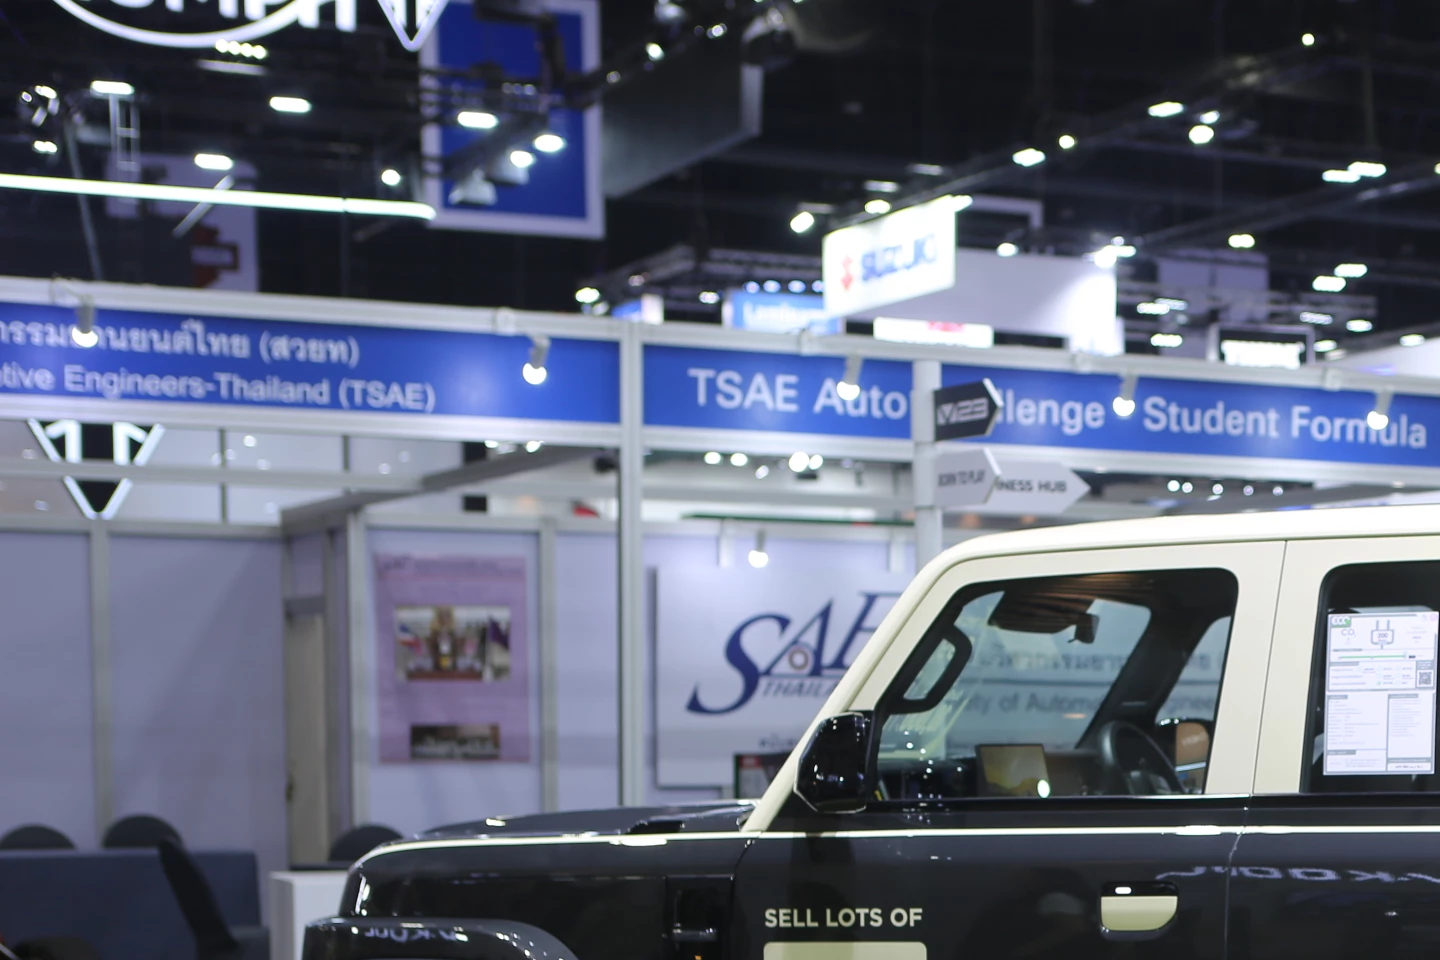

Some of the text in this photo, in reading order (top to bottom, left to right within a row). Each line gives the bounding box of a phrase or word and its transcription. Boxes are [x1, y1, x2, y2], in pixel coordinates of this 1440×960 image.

[339, 378, 436, 413] (TSAE)
[688, 368, 799, 412] TSAE
[1143, 396, 1279, 438] Student
[1291, 406, 1427, 449] Formula
[1038, 481, 1067, 492] HUB
[764, 908, 923, 928] SELL LOTS OF
